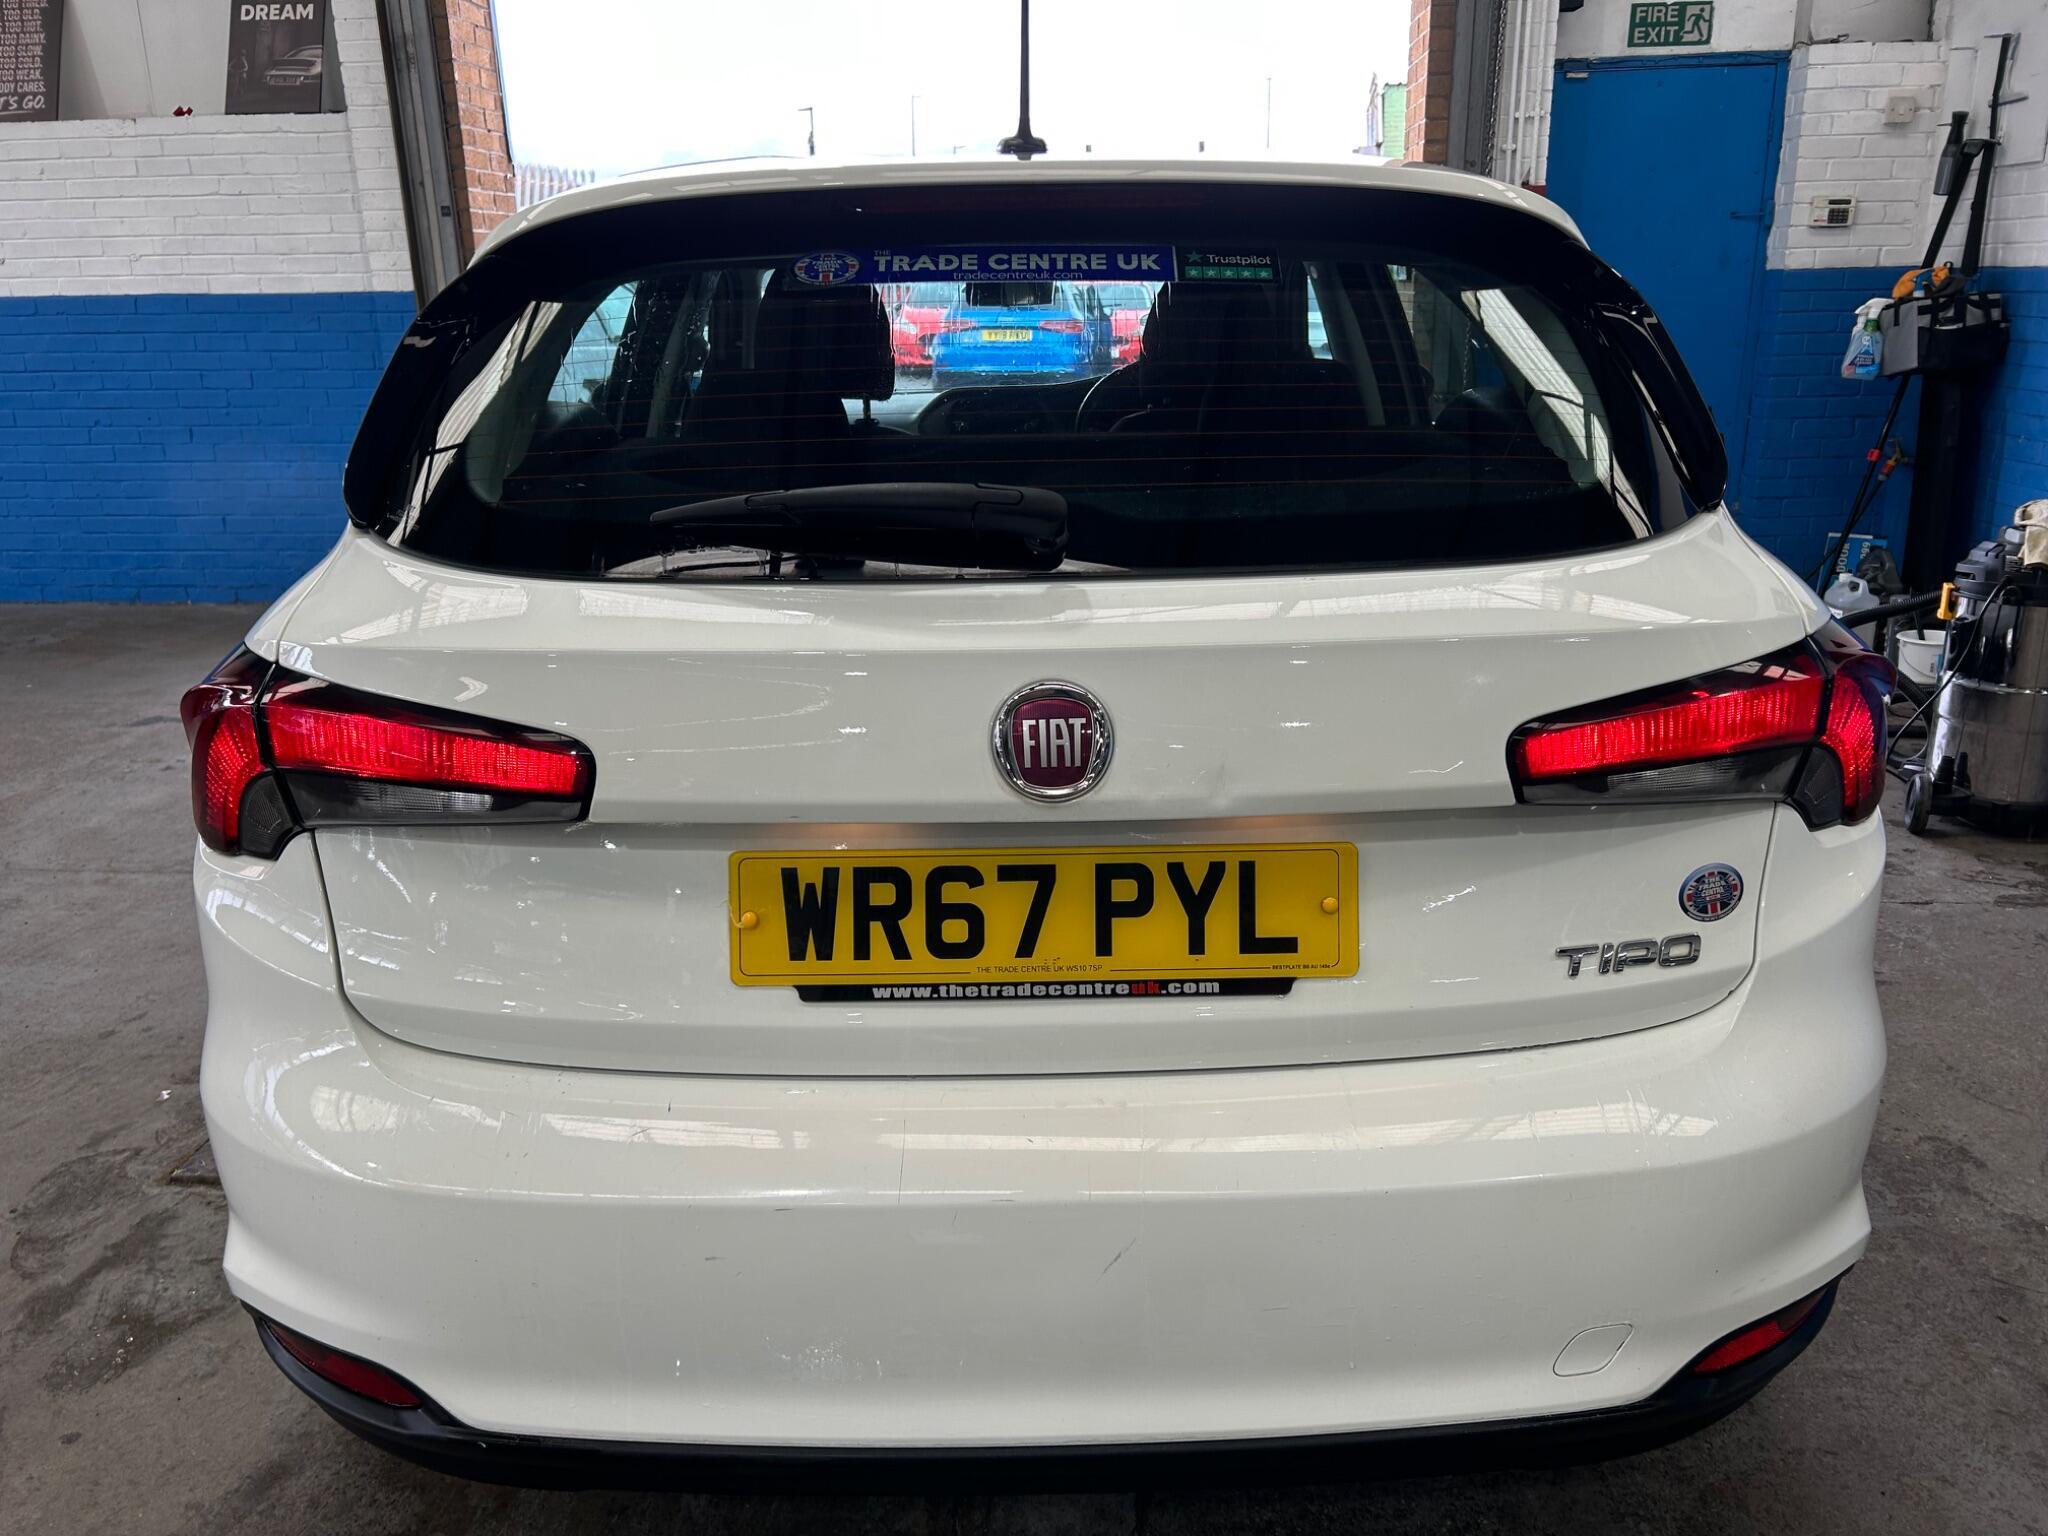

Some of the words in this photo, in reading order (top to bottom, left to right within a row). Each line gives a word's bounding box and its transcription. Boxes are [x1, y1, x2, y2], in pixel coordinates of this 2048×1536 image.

[3, 10, 21, 20] TOO
[22, 9, 42, 20] OLD.
[240, 3, 314, 21] DREAM
[1635, 5, 1679, 23] FIRE
[4, 22, 22, 32] TOO
[23, 21, 43, 32] HOT.
[0, 34, 17, 44] TOO
[18, 33, 46, 44] RAINY.
[1633, 26, 1678, 43] EXIT
[17, 45, 43, 56] SLOW.
[18, 57, 43, 68] COLD.
[16, 69, 43, 80] WEAK.
[17, 82, 46, 93] CARES.
[22, 95, 46, 110] GO.
[873, 254, 979, 272] TRADE
[987, 253, 1107, 271] CENTRE
[1117, 253, 1161, 271] UK
[1206, 254, 1272, 266] Trustpilot
[953, 271, 1084, 280] tradecentreuk.com
[1022, 717, 1087, 768] FIAT
[780, 862, 1058, 963] WR67
[1094, 859, 1300, 959] PYL
[1555, 932, 1702, 979] TIPO
[1020, 965, 1051, 973] CENTRE
[1053, 965, 1065, 973] UK
[1066, 964, 1087, 972] WS10
[1088, 964, 1103, 972] 7SP
[872, 980, 1221, 1000] www.thetradecentreuk.com
